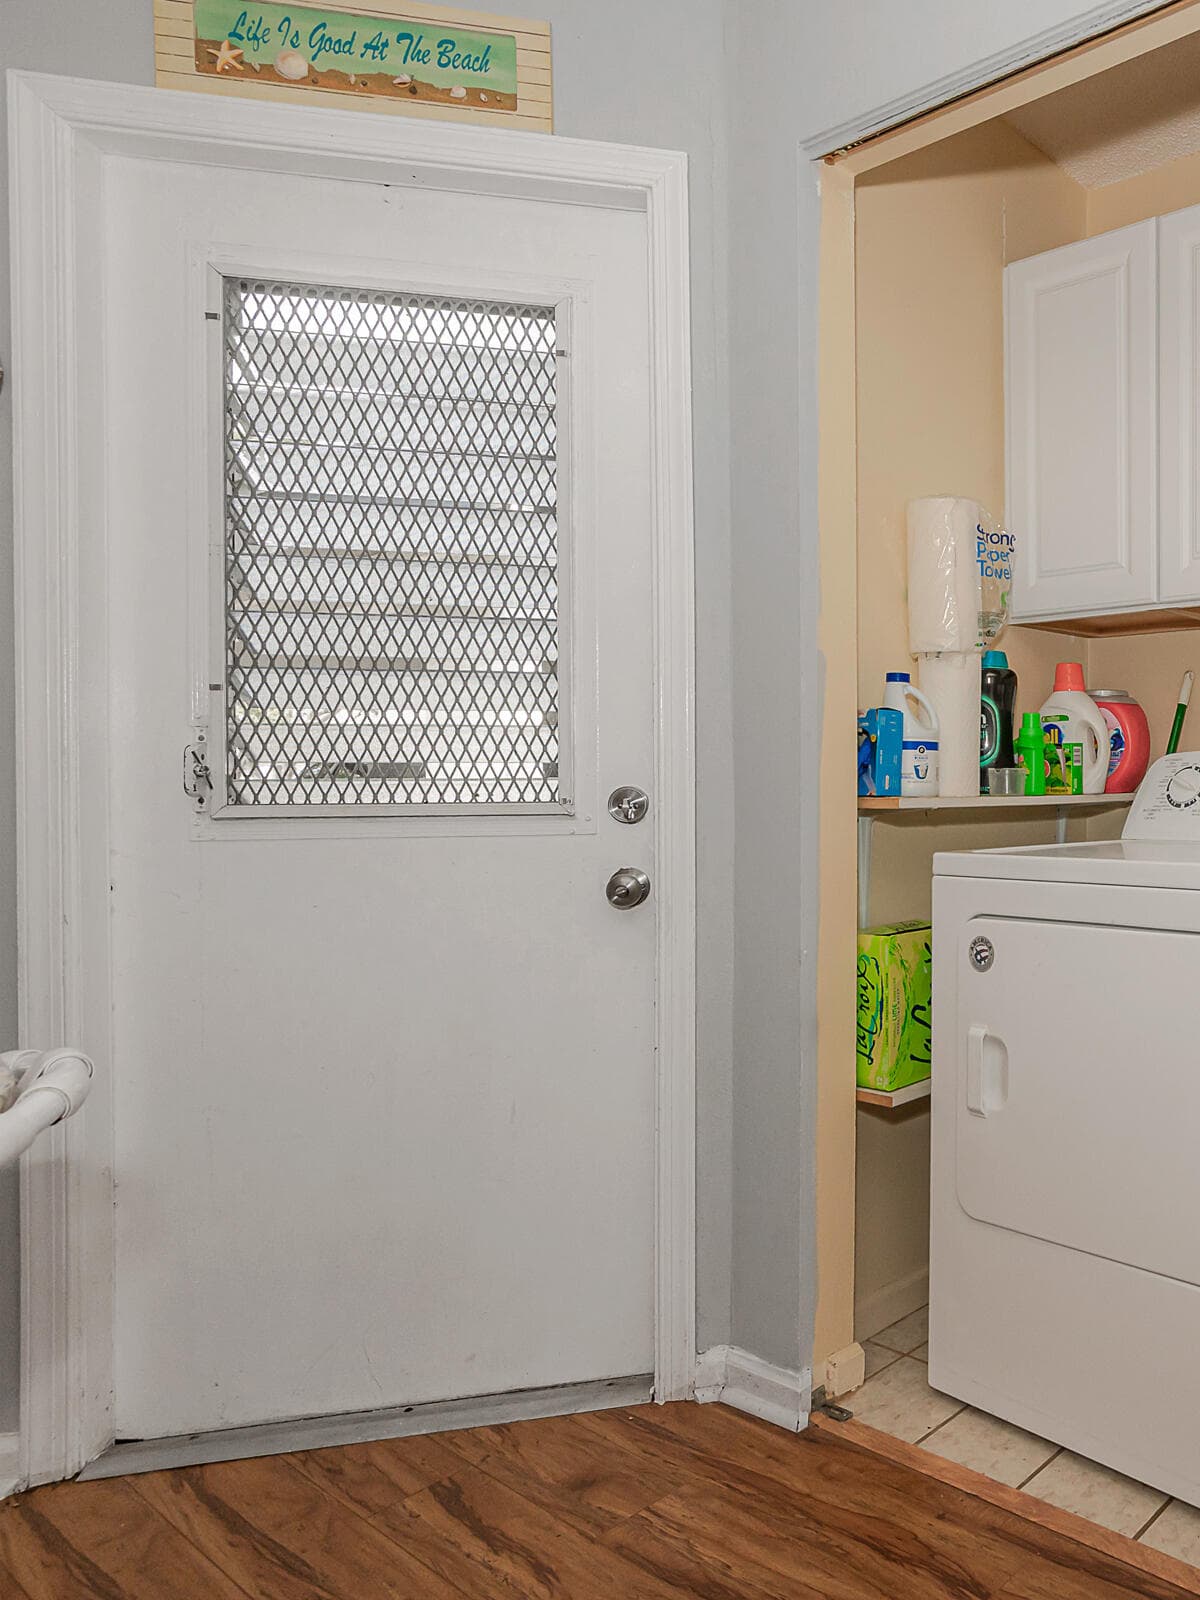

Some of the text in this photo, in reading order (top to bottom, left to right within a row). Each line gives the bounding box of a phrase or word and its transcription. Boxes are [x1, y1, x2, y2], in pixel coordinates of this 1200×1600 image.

[227, 11, 491, 73] Life Is Good At The Beach
